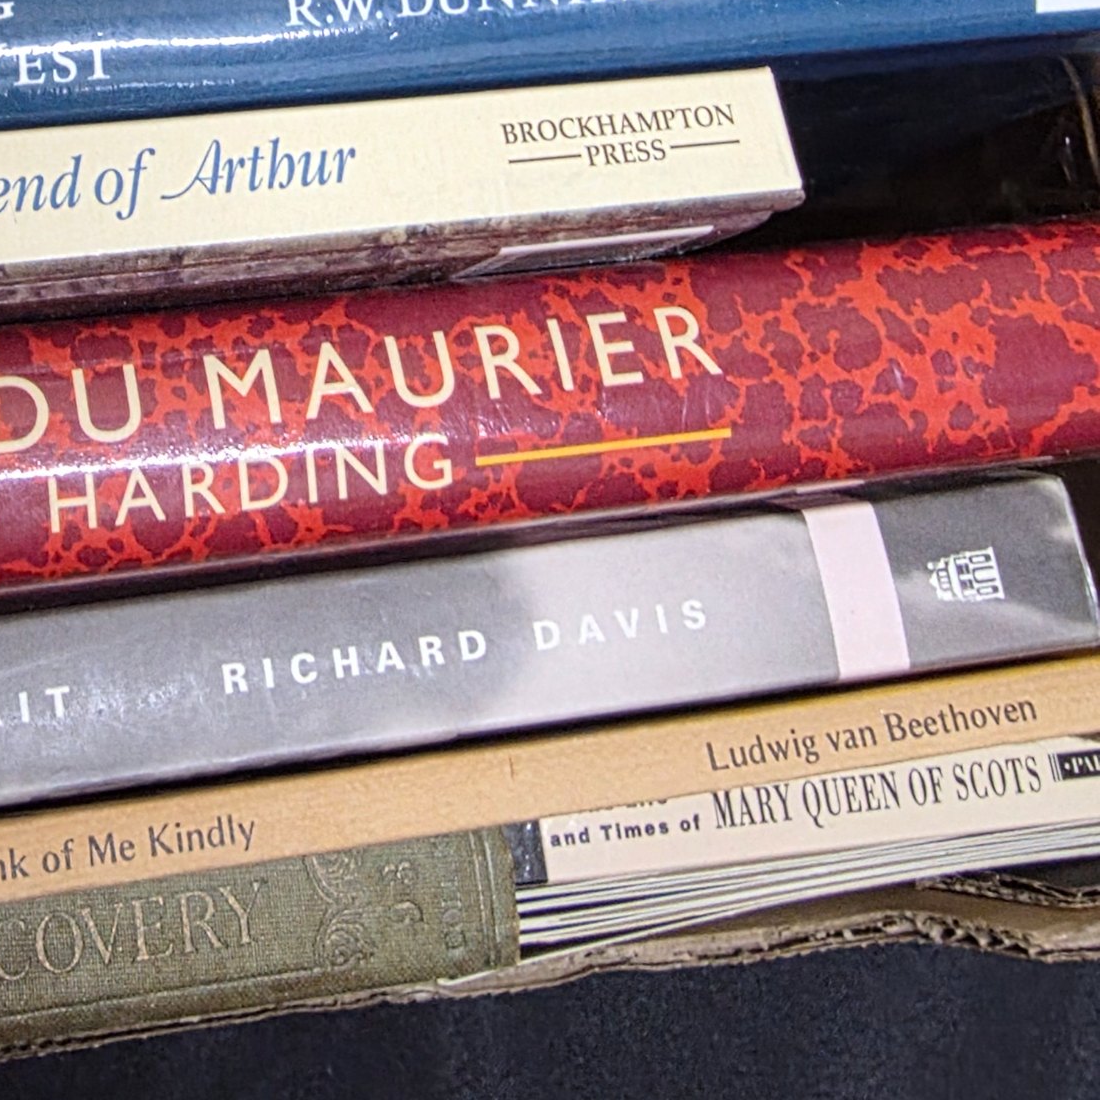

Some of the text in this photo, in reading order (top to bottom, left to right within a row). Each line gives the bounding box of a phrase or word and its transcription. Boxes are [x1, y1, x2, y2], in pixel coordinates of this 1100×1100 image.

[500, 103, 737, 146] BROCKHAMPTON
[584, 138, 668, 168] PRESS
[93, 147, 157, 221] of
[161, 136, 358, 201] Arthur
[203, 304, 724, 431] MAURIER
[47, 433, 454, 536] HARDING
[221, 629, 488, 695] RICHARD
[532, 599, 708, 652] DAVIS
[42, 838, 75, 875] of
[87, 832, 137, 868] Me
[148, 814, 256, 858] Kindly
[705, 728, 820, 772] Ludwig
[825, 724, 879, 754] van
[883, 698, 1039, 743] Beethoven
[550, 754, 1044, 848] and Times of MARY QUEEN OF SCOTS
